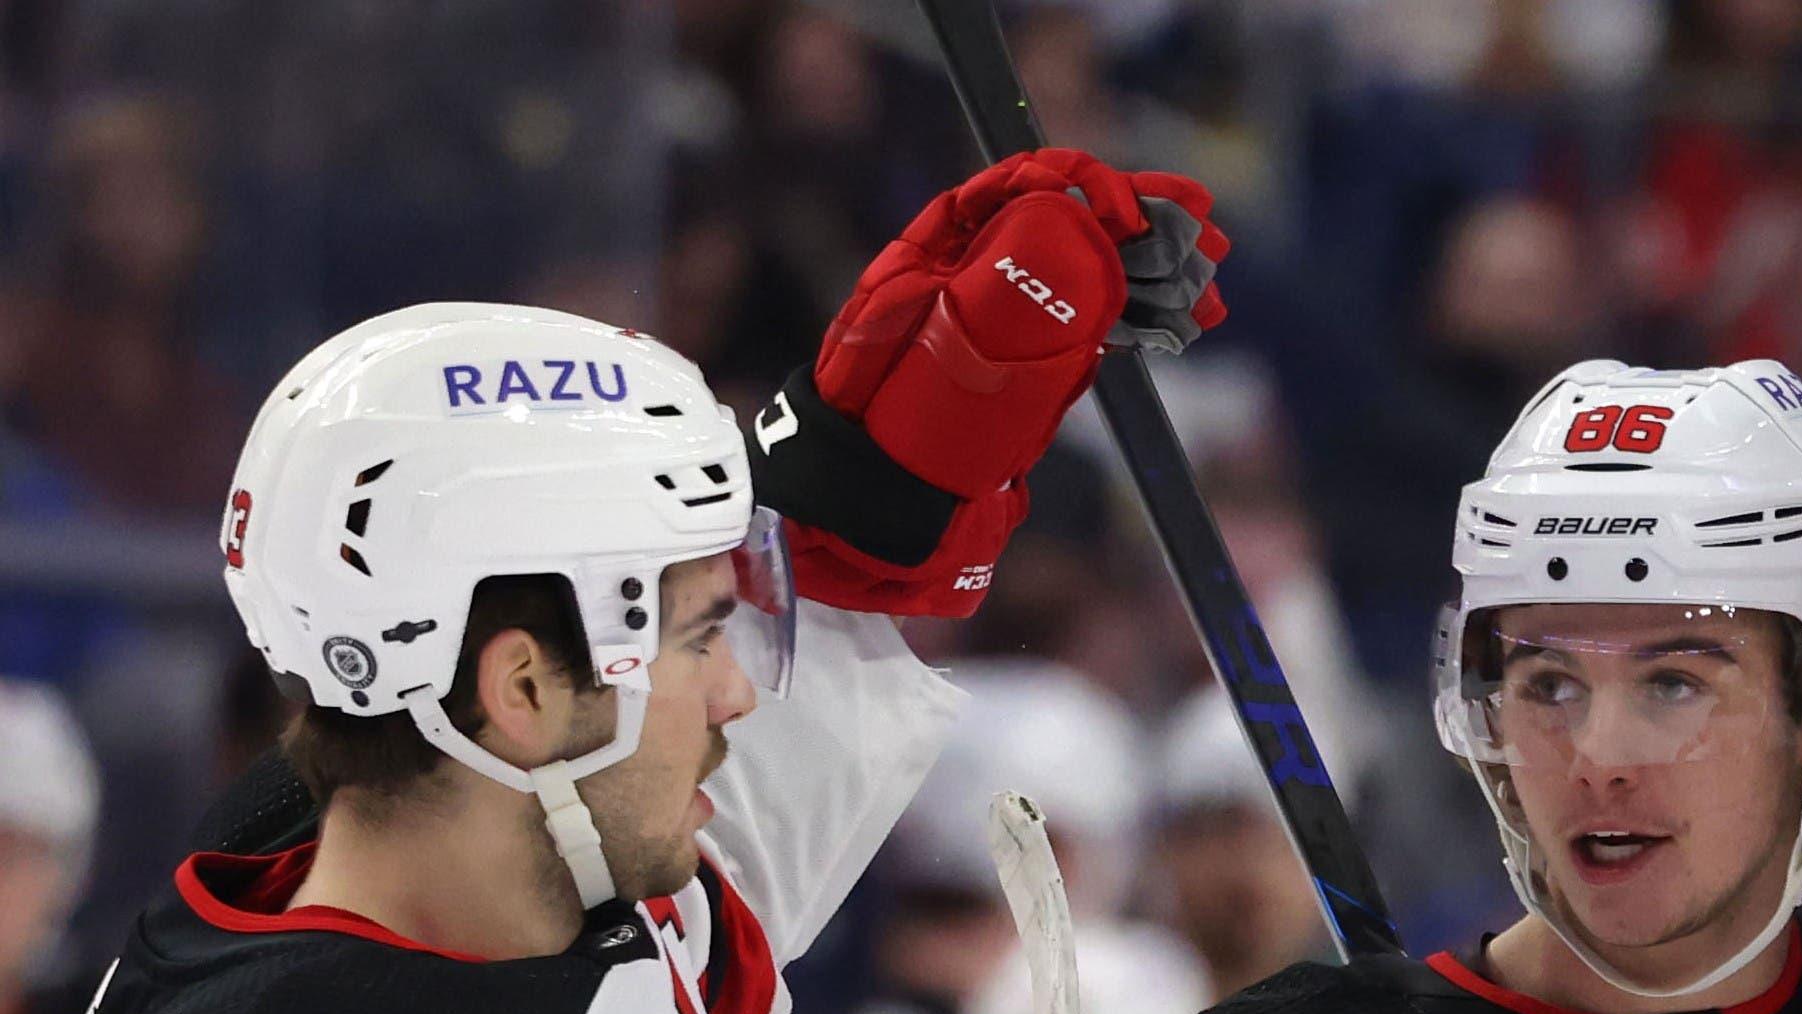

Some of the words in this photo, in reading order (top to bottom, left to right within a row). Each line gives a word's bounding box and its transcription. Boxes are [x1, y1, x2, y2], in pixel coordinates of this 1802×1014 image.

[994, 256, 1077, 324] CCM
[443, 360, 628, 407] RAZU
[1563, 404, 1675, 453] 86
[1534, 517, 1658, 536] BAUER
